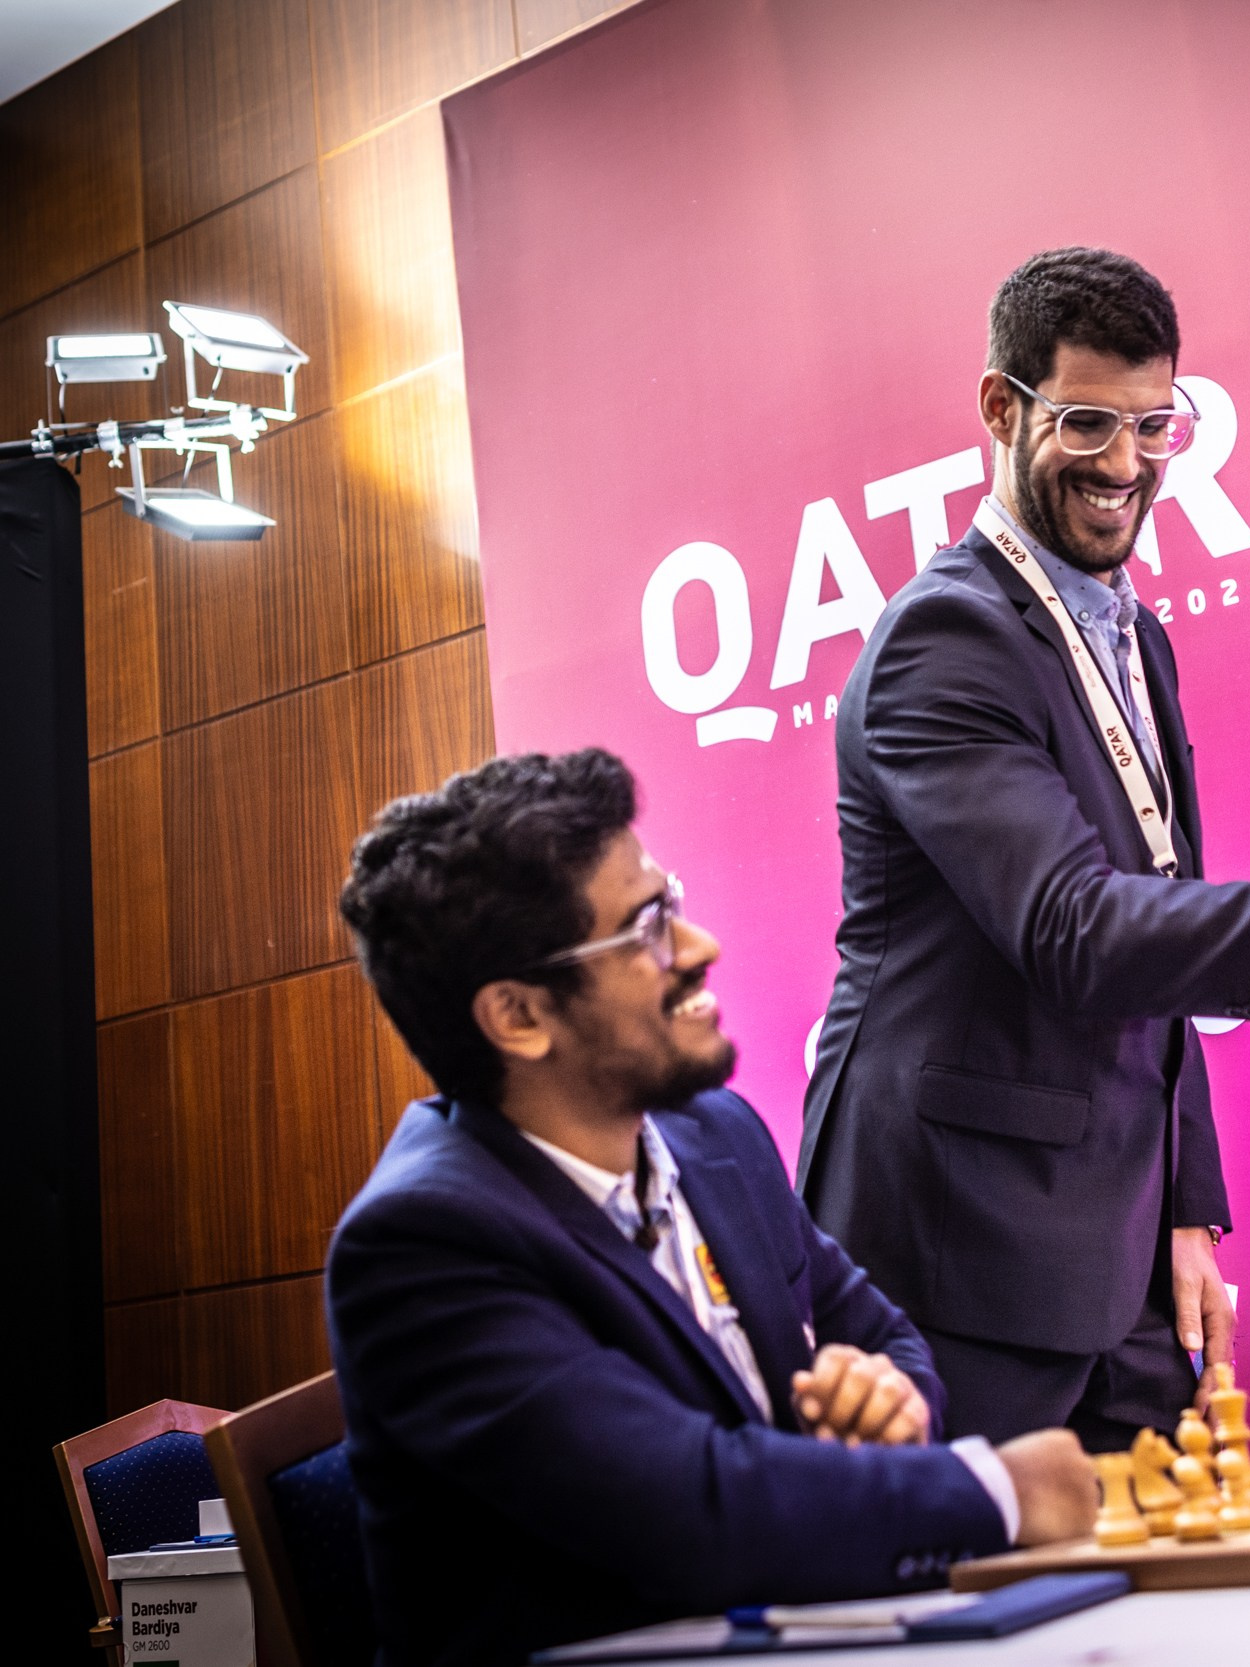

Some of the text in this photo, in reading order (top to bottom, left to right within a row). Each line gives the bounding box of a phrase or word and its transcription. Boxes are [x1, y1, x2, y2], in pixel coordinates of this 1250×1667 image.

[995, 531, 1028, 564] QATAR
[1106, 726, 1133, 768] QATAR
[131, 1599, 198, 1617] Daneshvar
[132, 1619, 180, 1637] Bardiya
[132, 1639, 170, 1652] GM 2600
